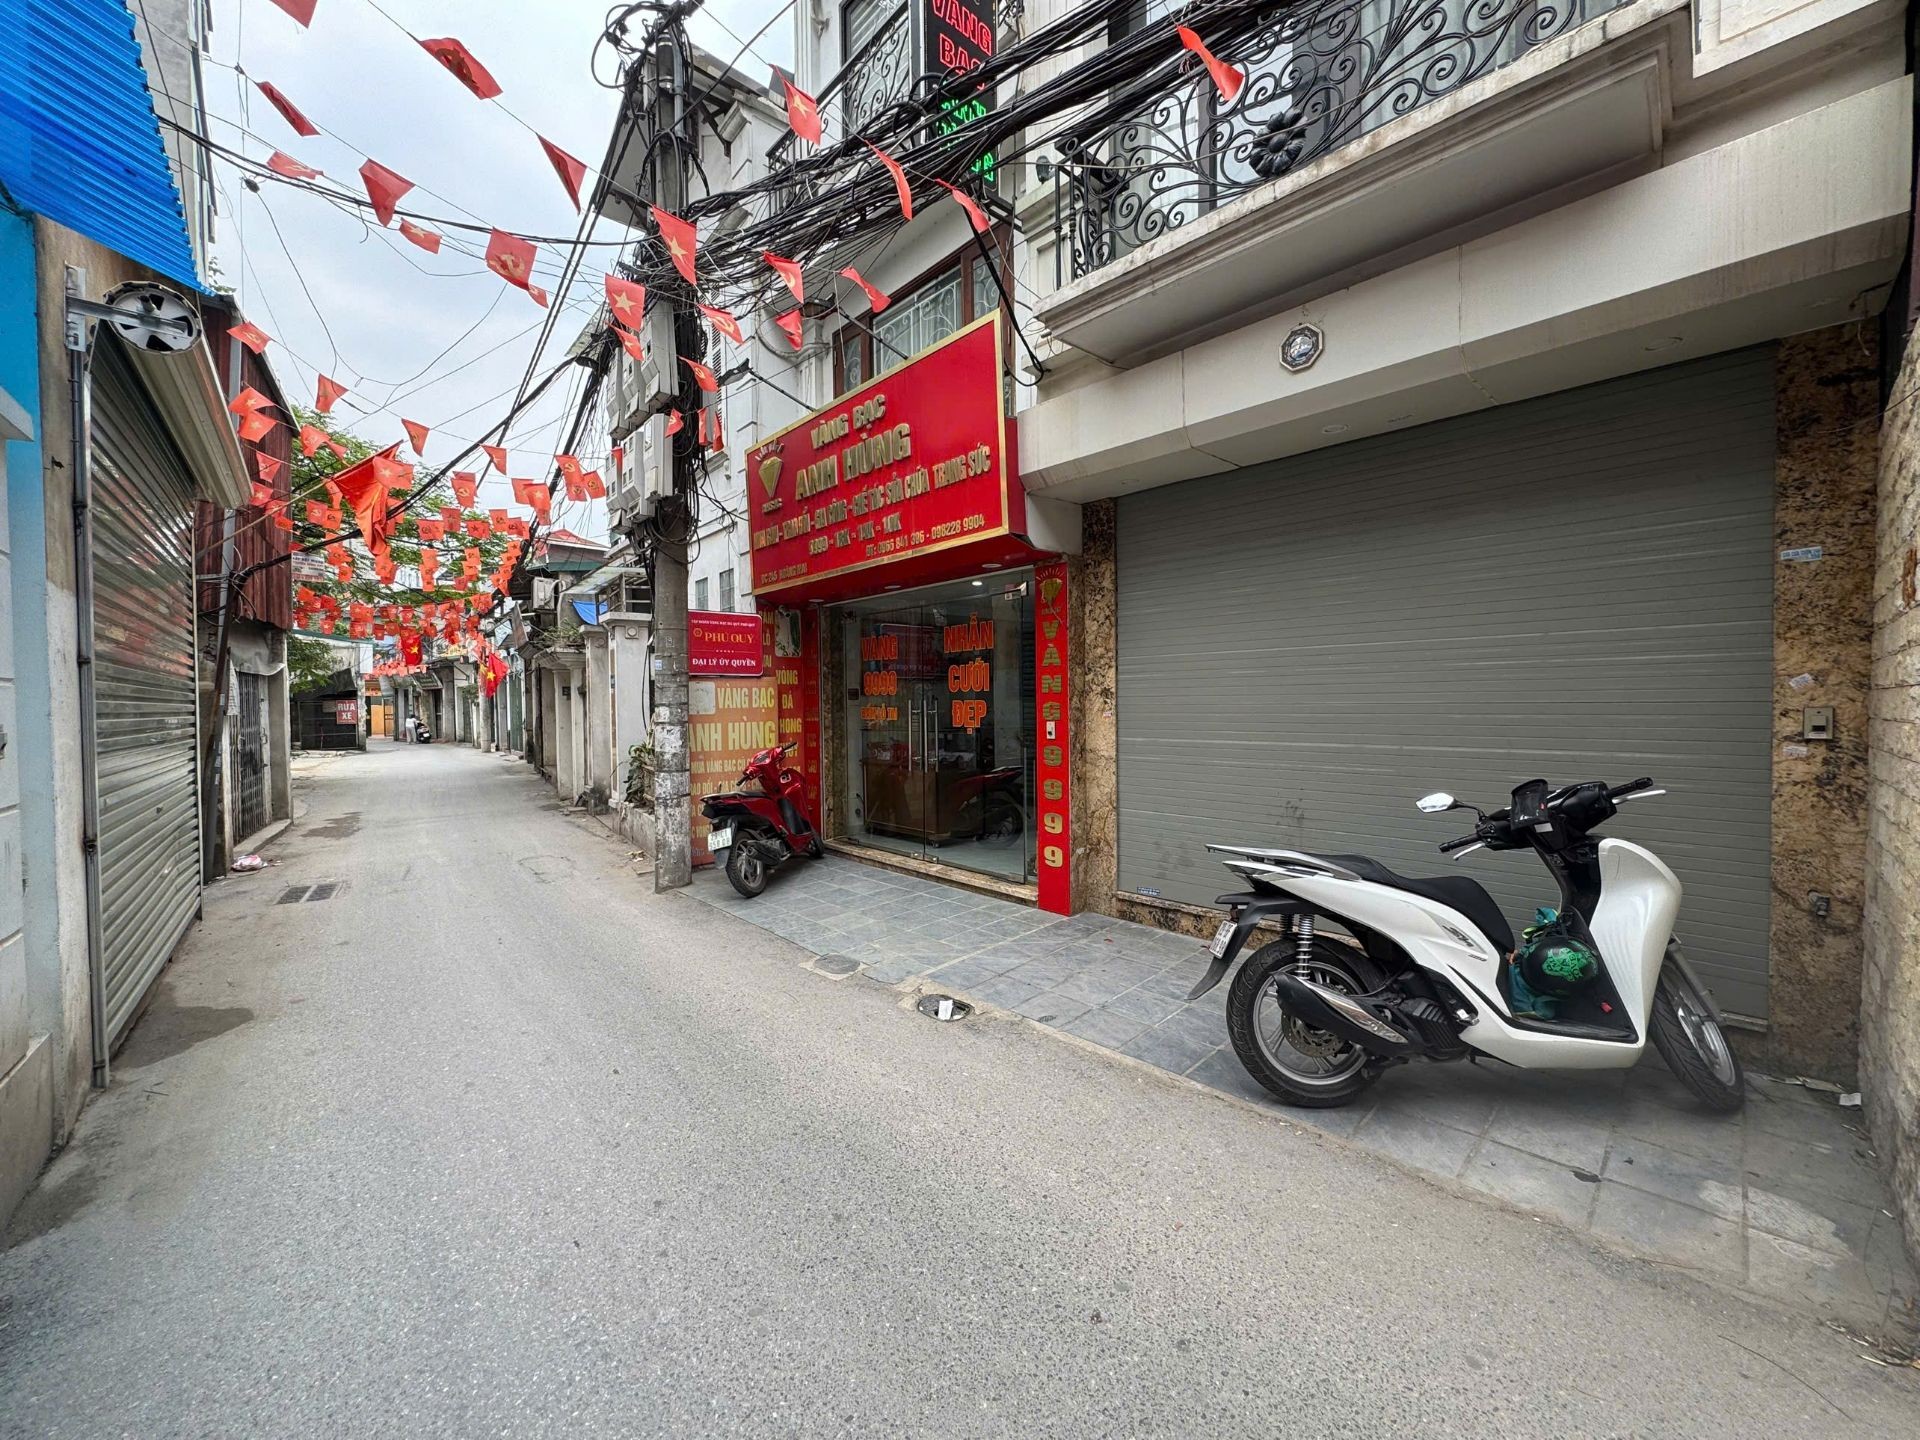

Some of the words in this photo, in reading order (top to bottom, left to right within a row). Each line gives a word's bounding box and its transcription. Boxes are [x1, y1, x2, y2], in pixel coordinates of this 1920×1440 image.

[811, 413, 849, 449] VÀNG
[852, 393, 886, 430] BẠC
[795, 454, 838, 500] ANH
[842, 423, 911, 481] HÙNG
[932, 454, 967, 489] TRANG
[967, 442, 991, 477] SỨC
[931, 520, 961, 539] 098228
[963, 513, 985, 531] 9904
[730, 633, 755, 644] QUÝ
[863, 632, 898, 661] VÀNG
[692, 657, 708, 667] ĐẠI
[708, 657, 719, 666] LÝ
[731, 657, 756, 667] QUYỀN
[776, 665, 799, 685] VÒNG
[948, 657, 990, 693] CƯỚI
[717, 683, 749, 709] VÀNG
[752, 687, 775, 713] BẠC
[863, 671, 898, 696] 9999
[342, 712, 352, 720] XE
[780, 718, 802, 733] HONG
[952, 700, 987, 734] ĐẸP
[727, 715, 776, 751] HÙNG
[707, 758, 722, 773] VÀNG
[1043, 745, 1063, 868] 9999
